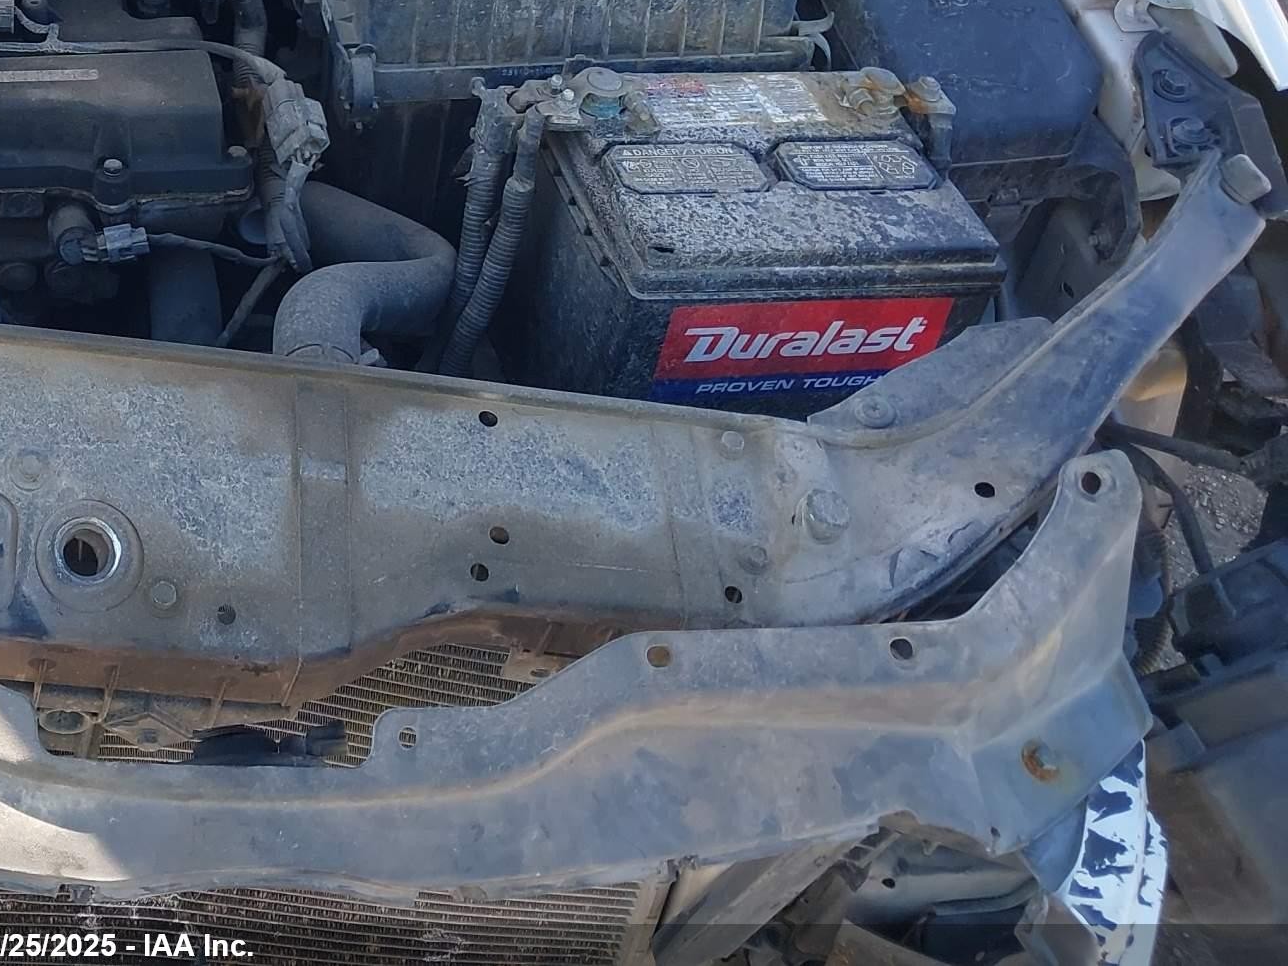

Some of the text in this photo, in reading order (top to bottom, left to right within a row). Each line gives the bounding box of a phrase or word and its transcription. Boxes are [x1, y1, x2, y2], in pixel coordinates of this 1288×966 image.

[633, 148, 680, 156] DANGER
[683, 316, 928, 363] Duralast
[695, 374, 883, 395] PROVEN TOUGH
